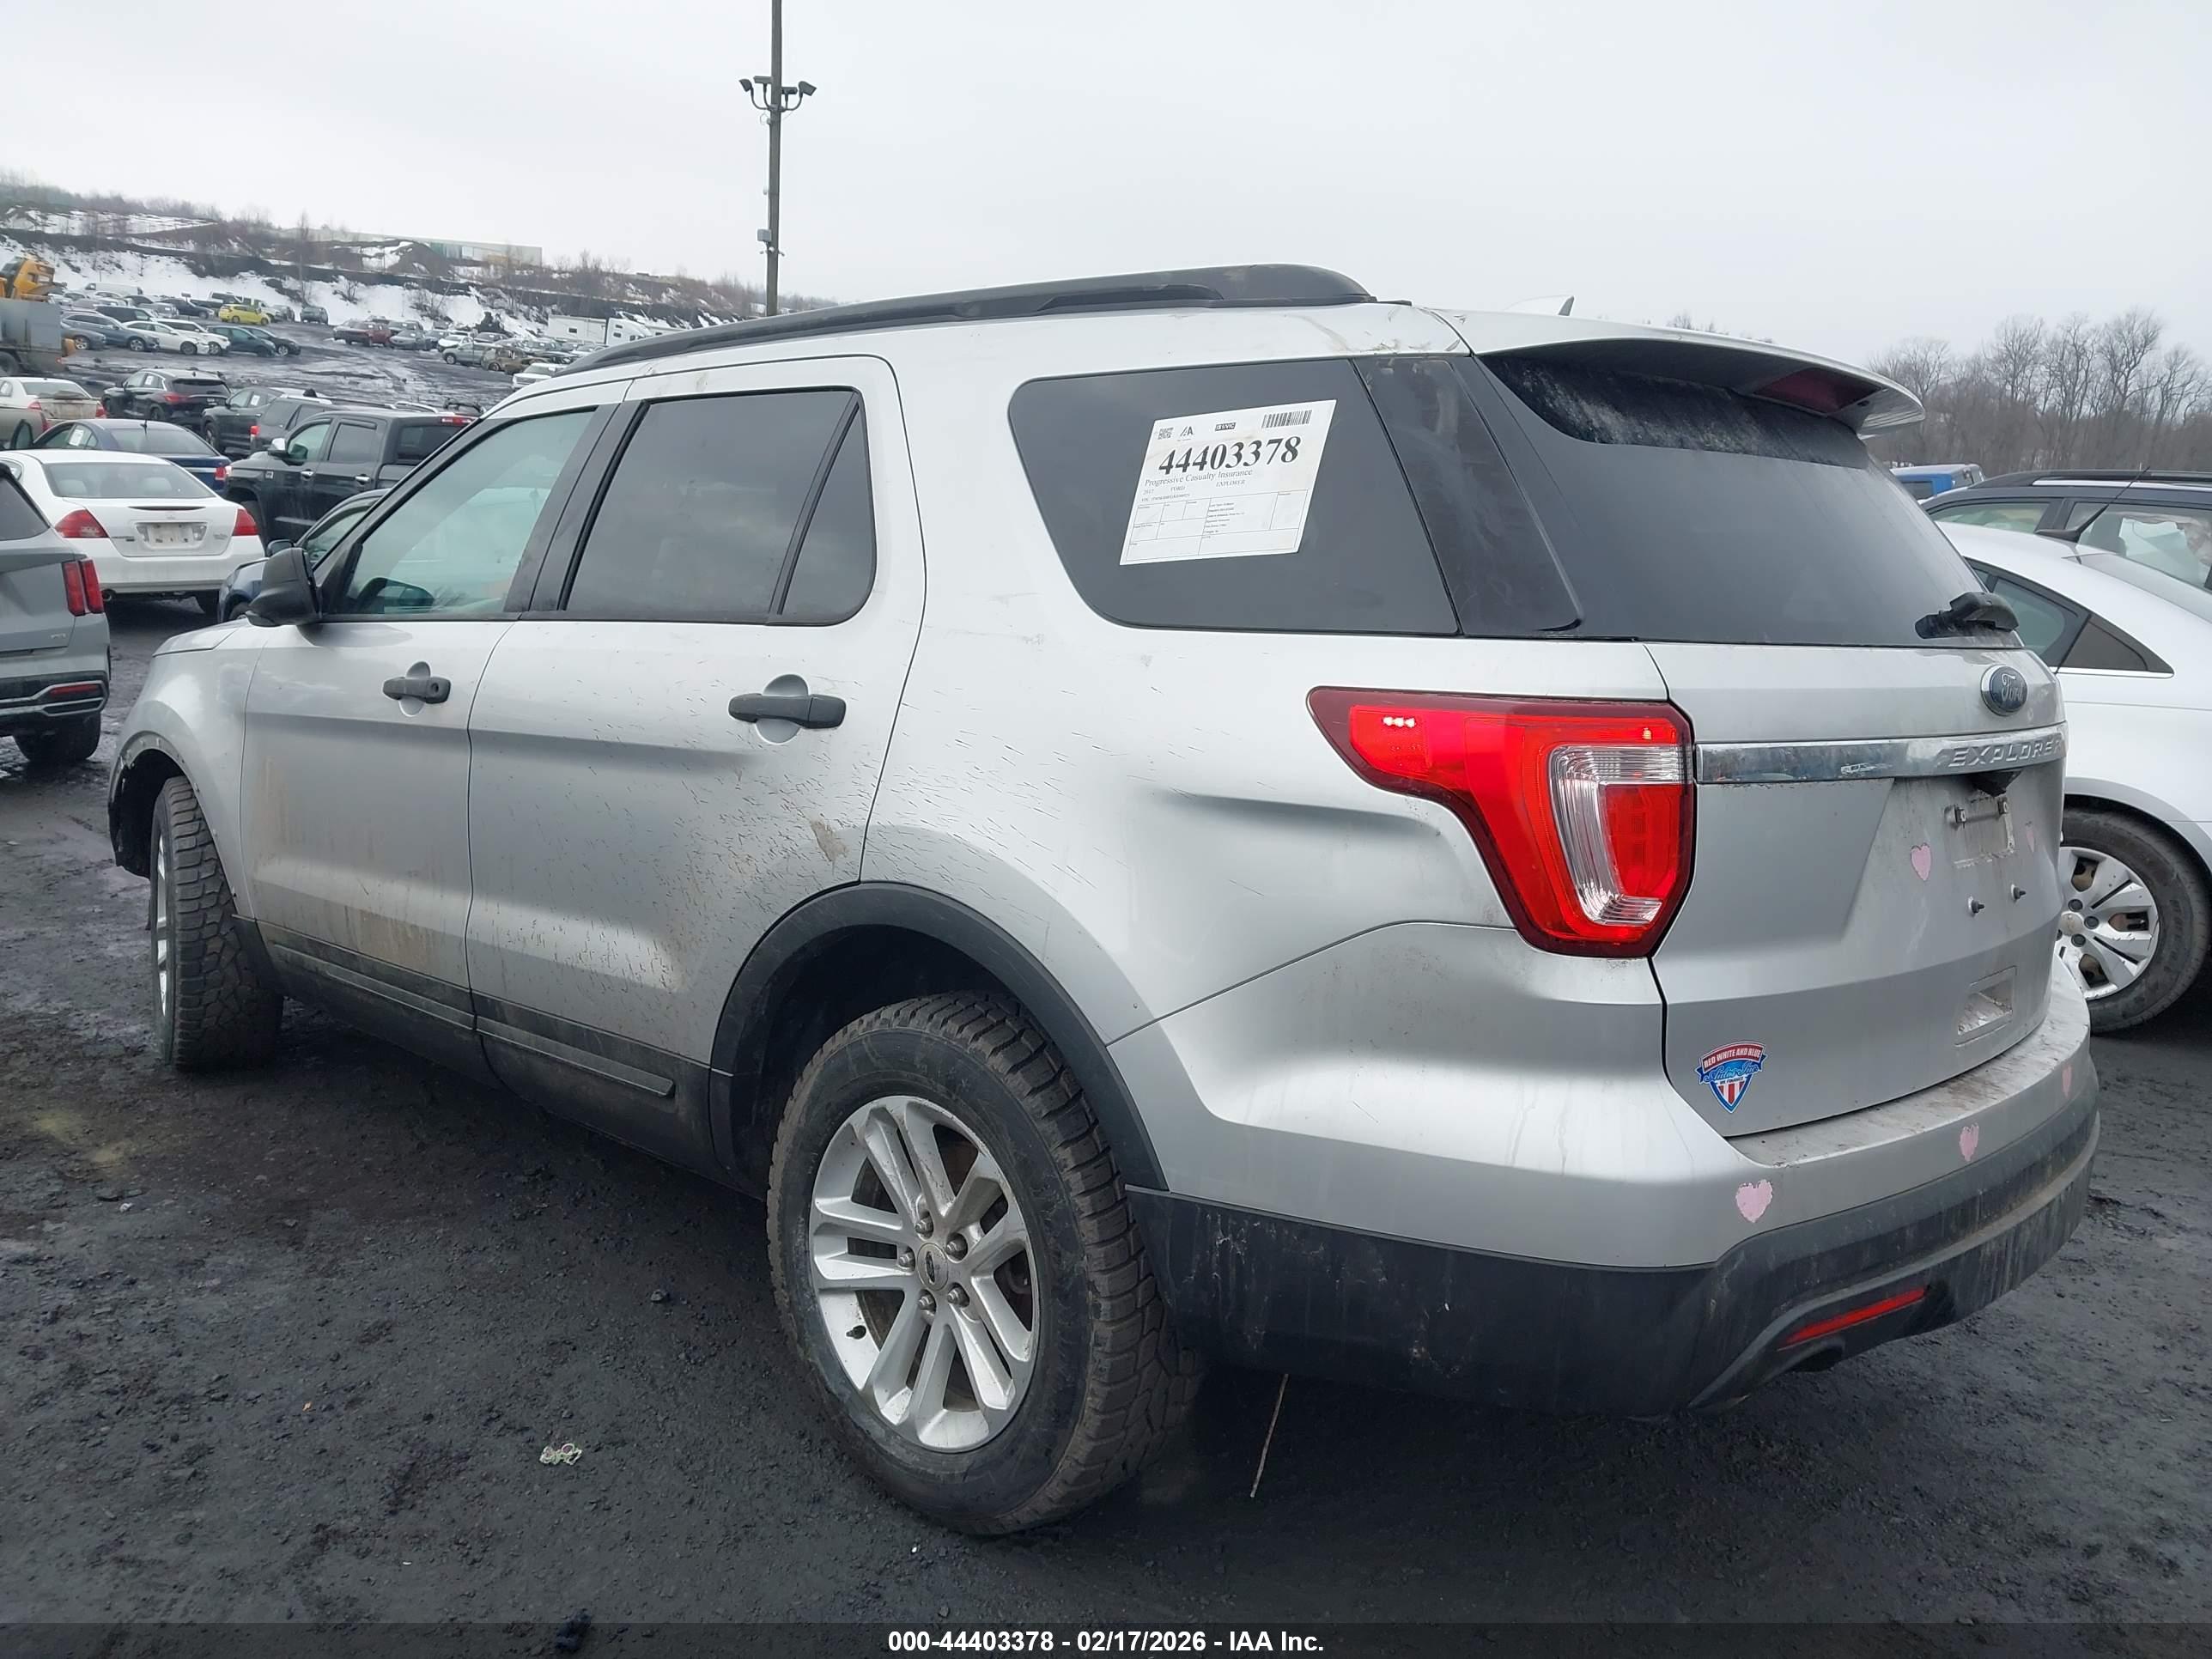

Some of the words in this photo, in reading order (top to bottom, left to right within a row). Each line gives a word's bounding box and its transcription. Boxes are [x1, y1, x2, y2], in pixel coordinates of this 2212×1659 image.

[1158, 436, 1302, 475] 44403378
[1145, 477, 1184, 488] Progressive
[1186, 472, 1216, 482] Casualty
[1218, 470, 1253, 479] Insurance
[2001, 673, 2024, 702] Ford
[1948, 739, 2063, 768] EXPLORER
[1704, 1058, 1716, 1068] RED
[1717, 1049, 1735, 1061] WHITE
[1735, 1048, 1747, 1056] AND
[1747, 1048, 1761, 1058] BLUE
